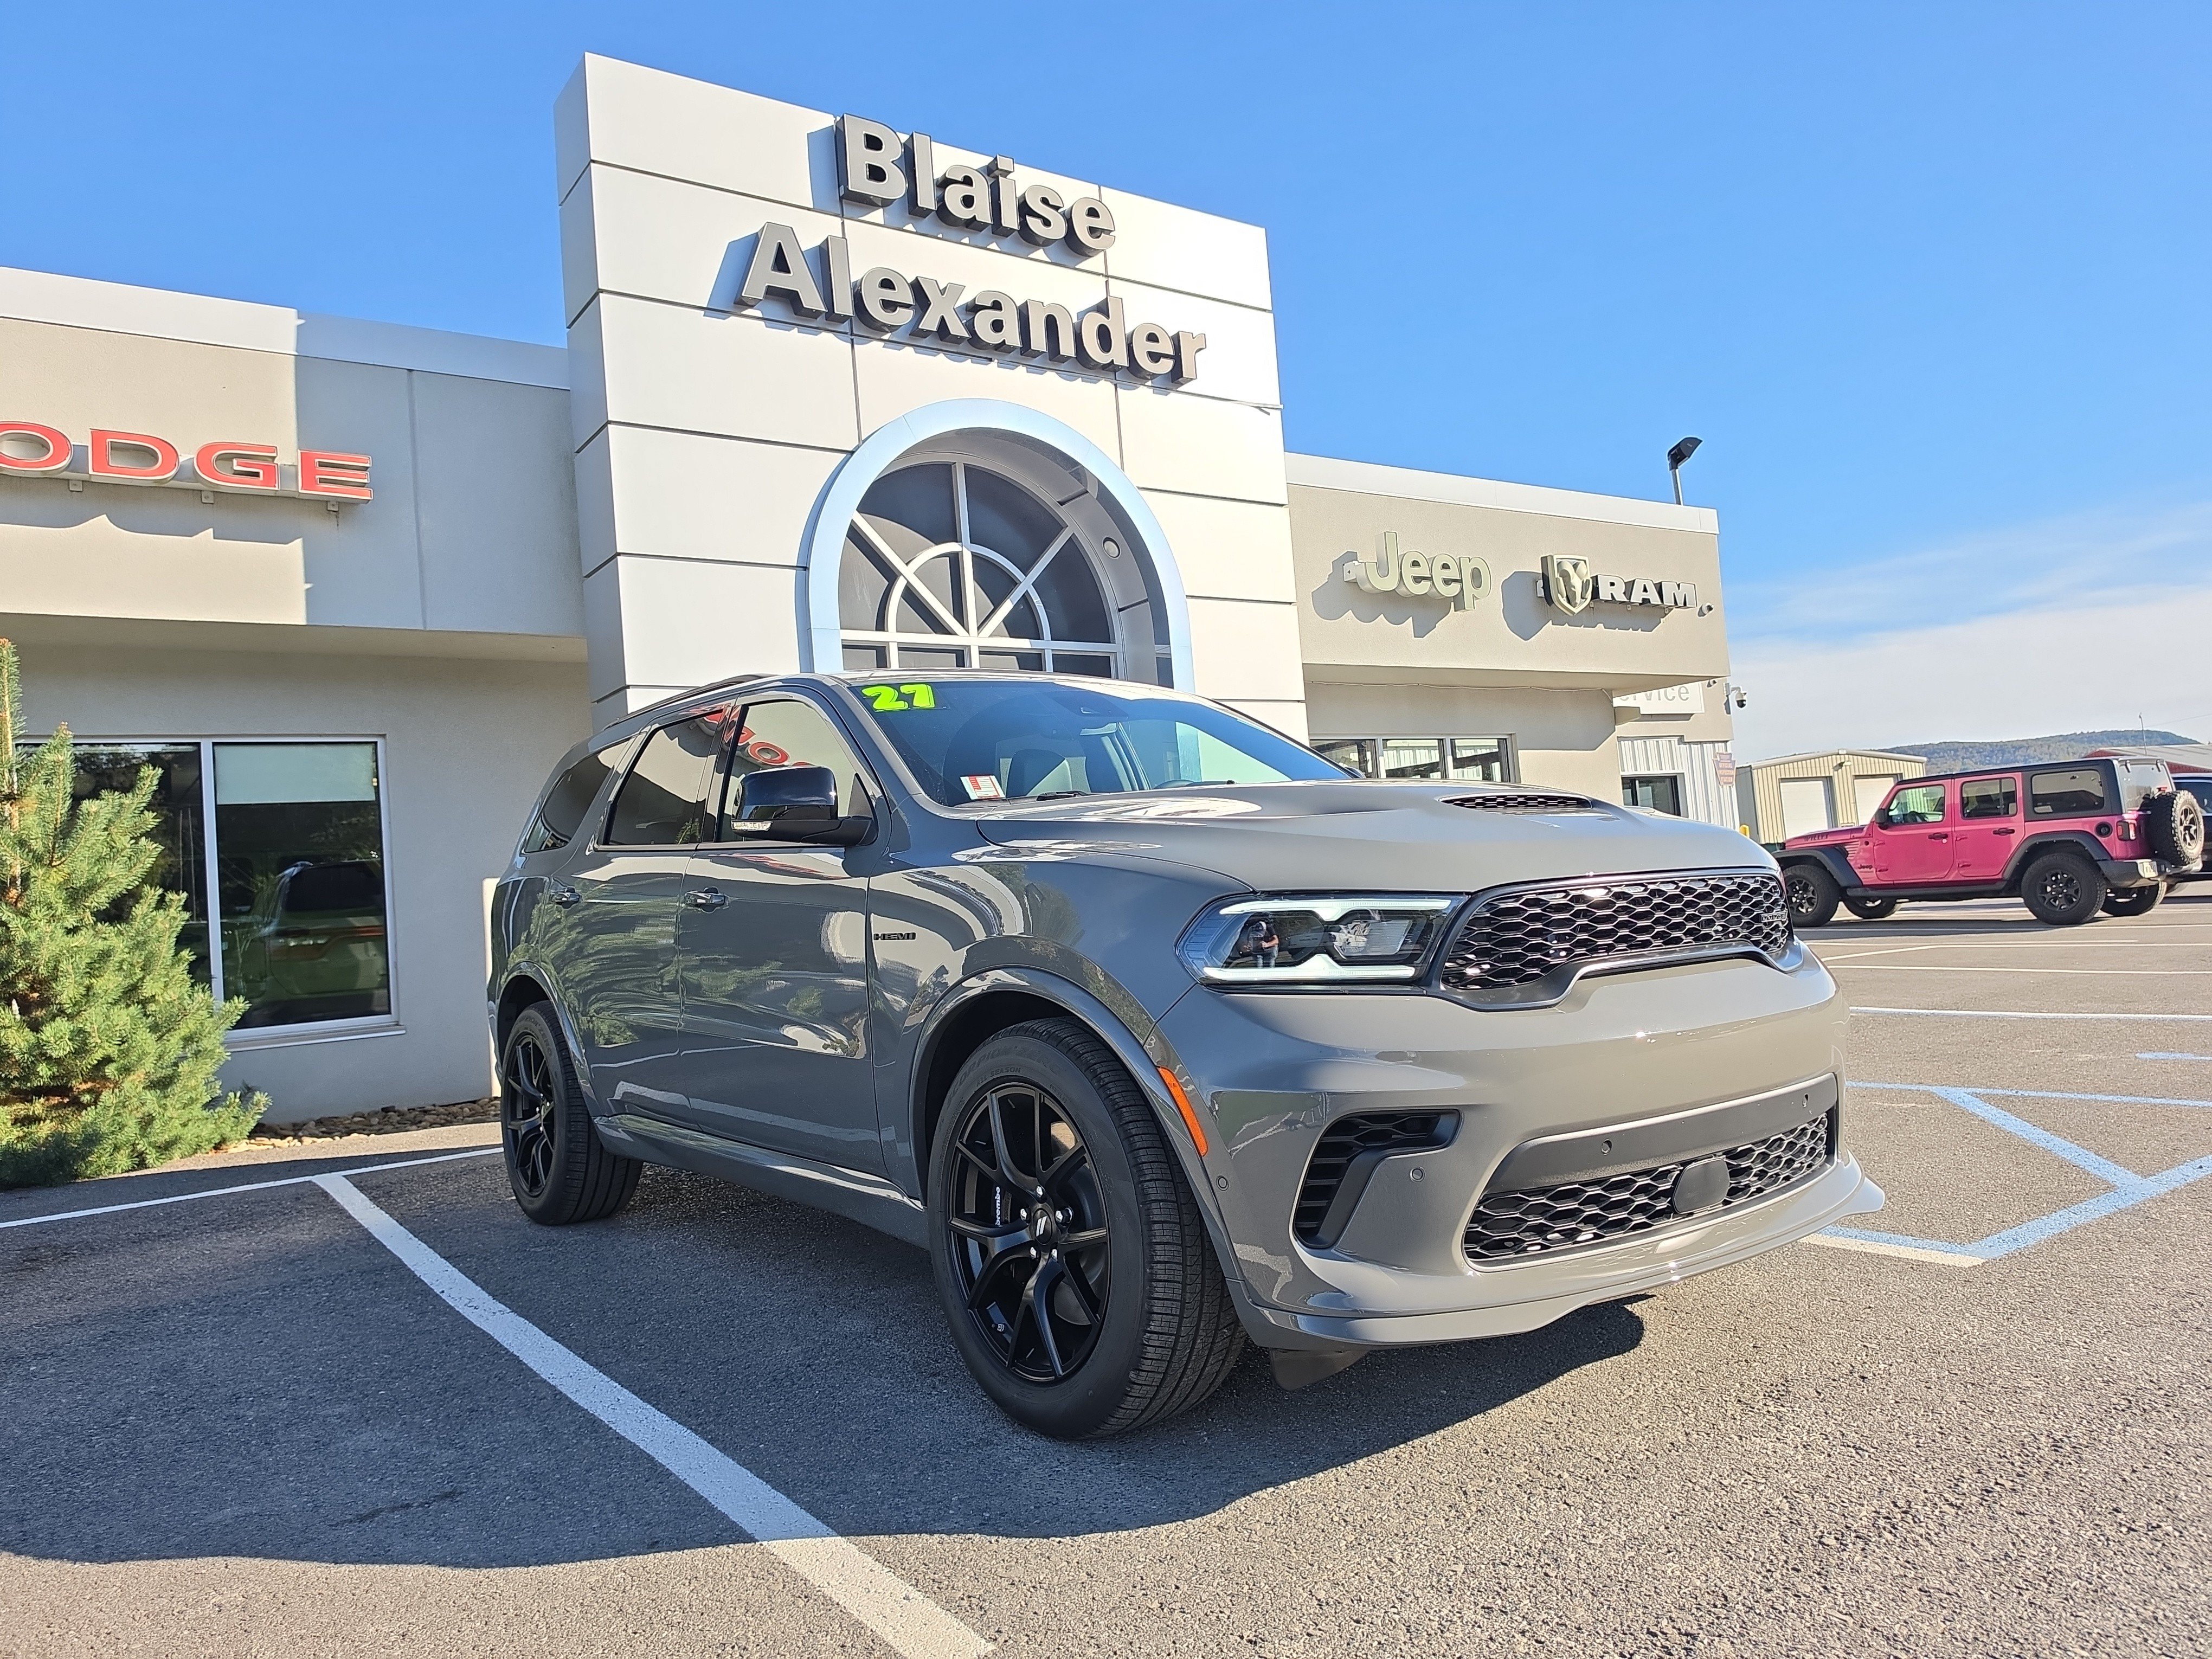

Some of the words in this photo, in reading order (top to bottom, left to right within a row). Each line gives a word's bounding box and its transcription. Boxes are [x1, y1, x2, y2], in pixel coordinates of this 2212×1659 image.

[838, 113, 1116, 255] Blaise
[737, 221, 1206, 383] Alexander
[0, 421, 374, 502] ODGE
[1360, 531, 1491, 611] Jeep
[1597, 574, 1698, 608] RAM
[861, 684, 935, 711] 27
[1619, 686, 1689, 702] vice
